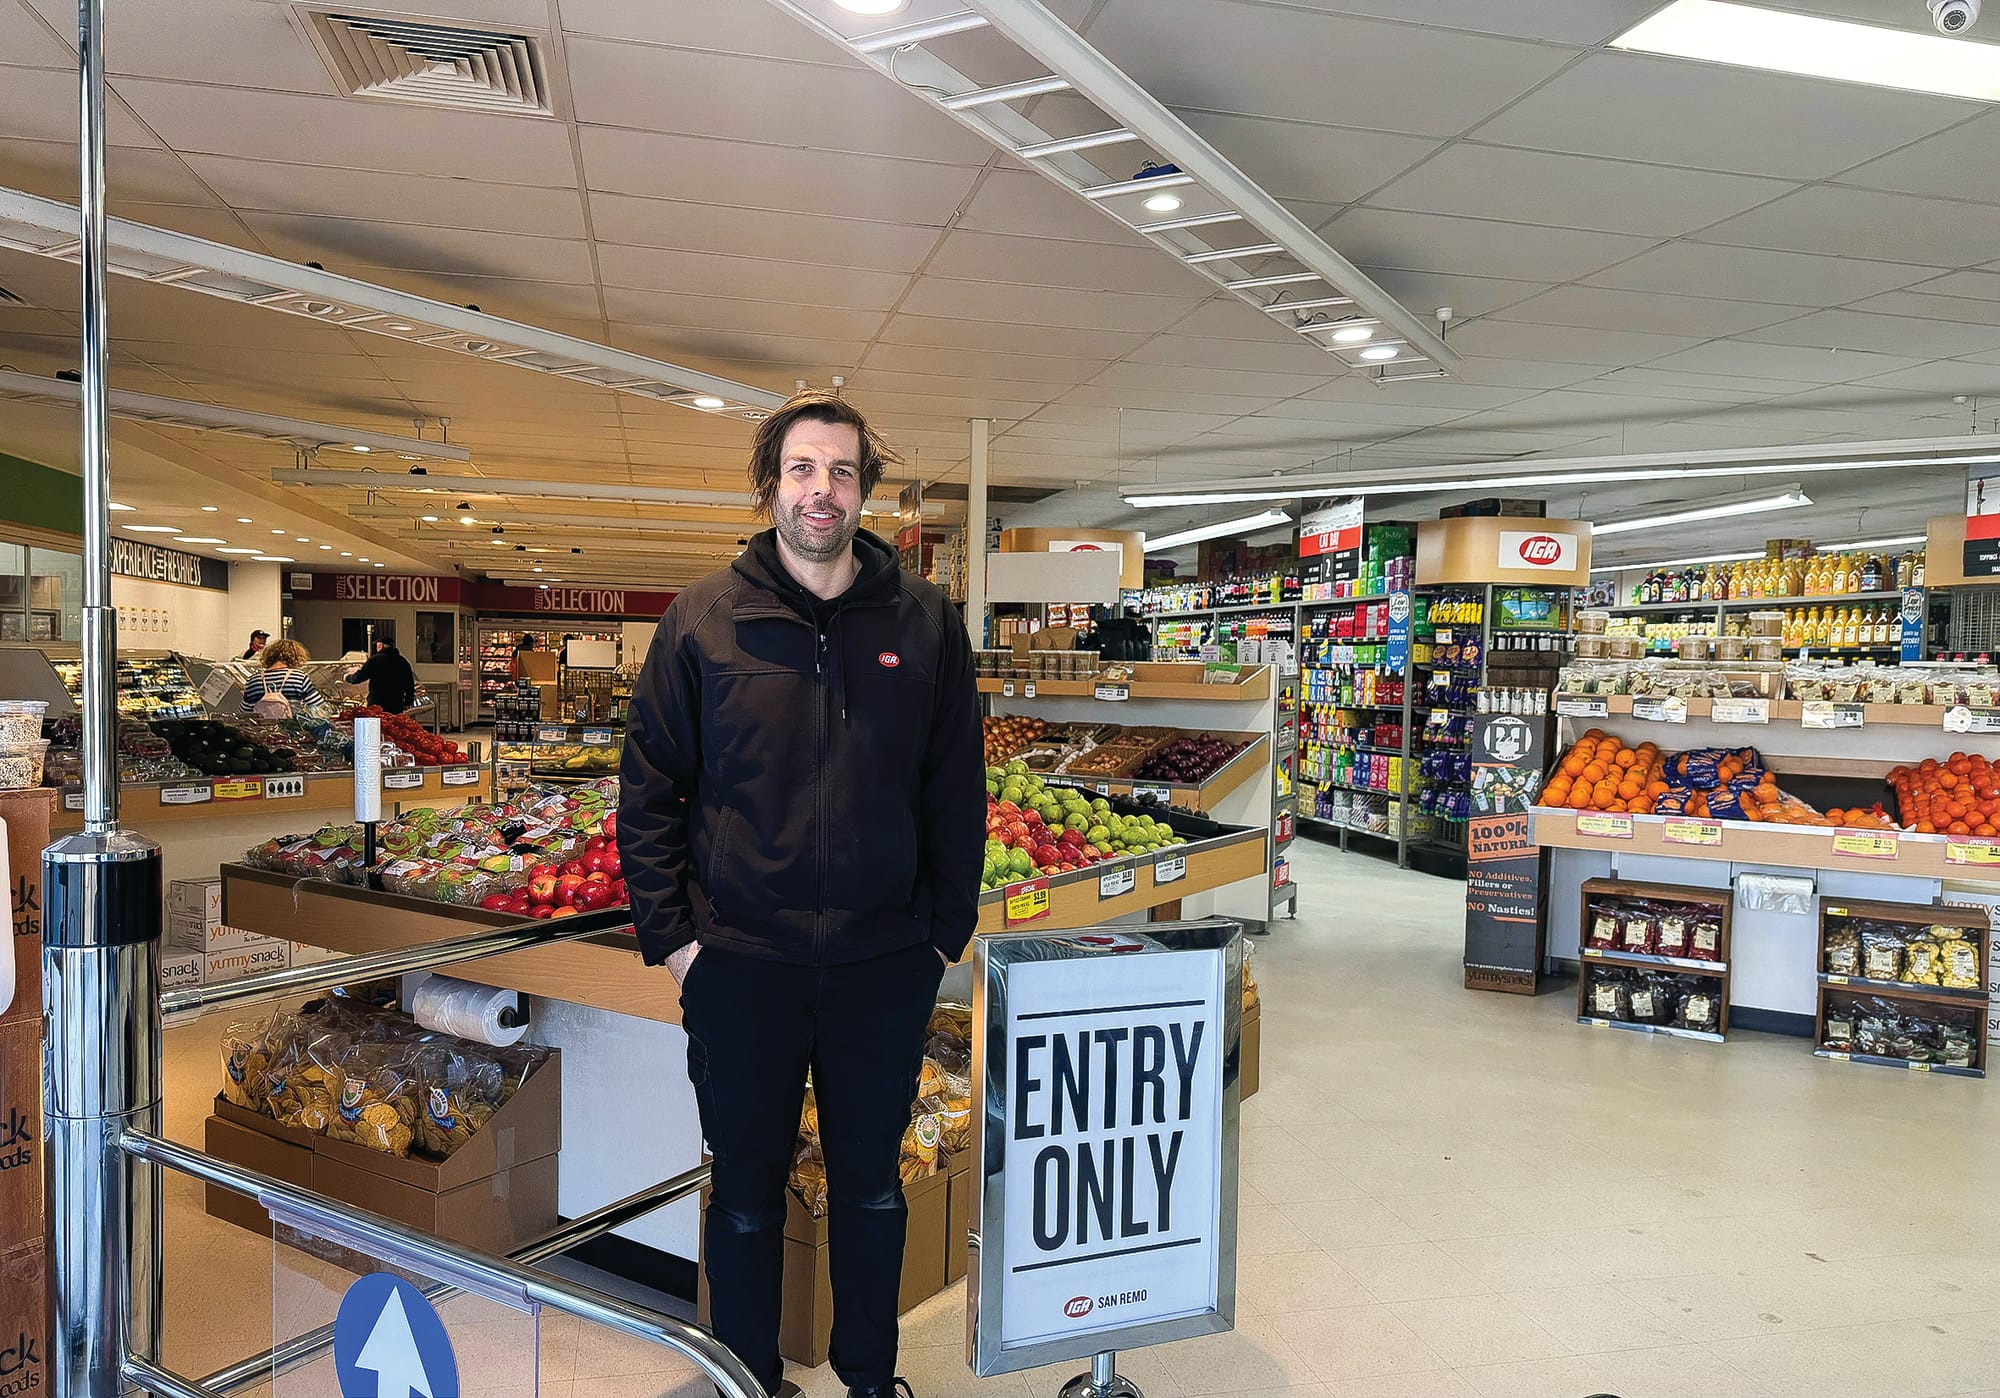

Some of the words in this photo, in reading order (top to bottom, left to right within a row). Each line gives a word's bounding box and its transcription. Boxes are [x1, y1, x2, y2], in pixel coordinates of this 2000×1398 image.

[163, 550, 201, 586] FRESHNESS
[346, 575, 438, 602] SELECTION
[543, 588, 625, 613] SELECTION
[881, 655, 898, 665] IGA
[1472, 821, 1528, 840] 100%
[1469, 870, 1483, 879] NO
[1485, 872, 1533, 882] Additives,
[1469, 880, 1500, 889] Fillers
[1469, 888, 1533, 900] Preservatives
[1468, 902, 1485, 911] NO
[1488, 903, 1536, 916] Nasties!
[162, 960, 199, 979] snack
[1014, 1021, 1205, 1140] ENTRY
[1033, 1130, 1184, 1251] ONLY
[1066, 1299, 1091, 1315] IGA
[1098, 1295, 1118, 1309] SAN
[1120, 1289, 1147, 1305] REMO
